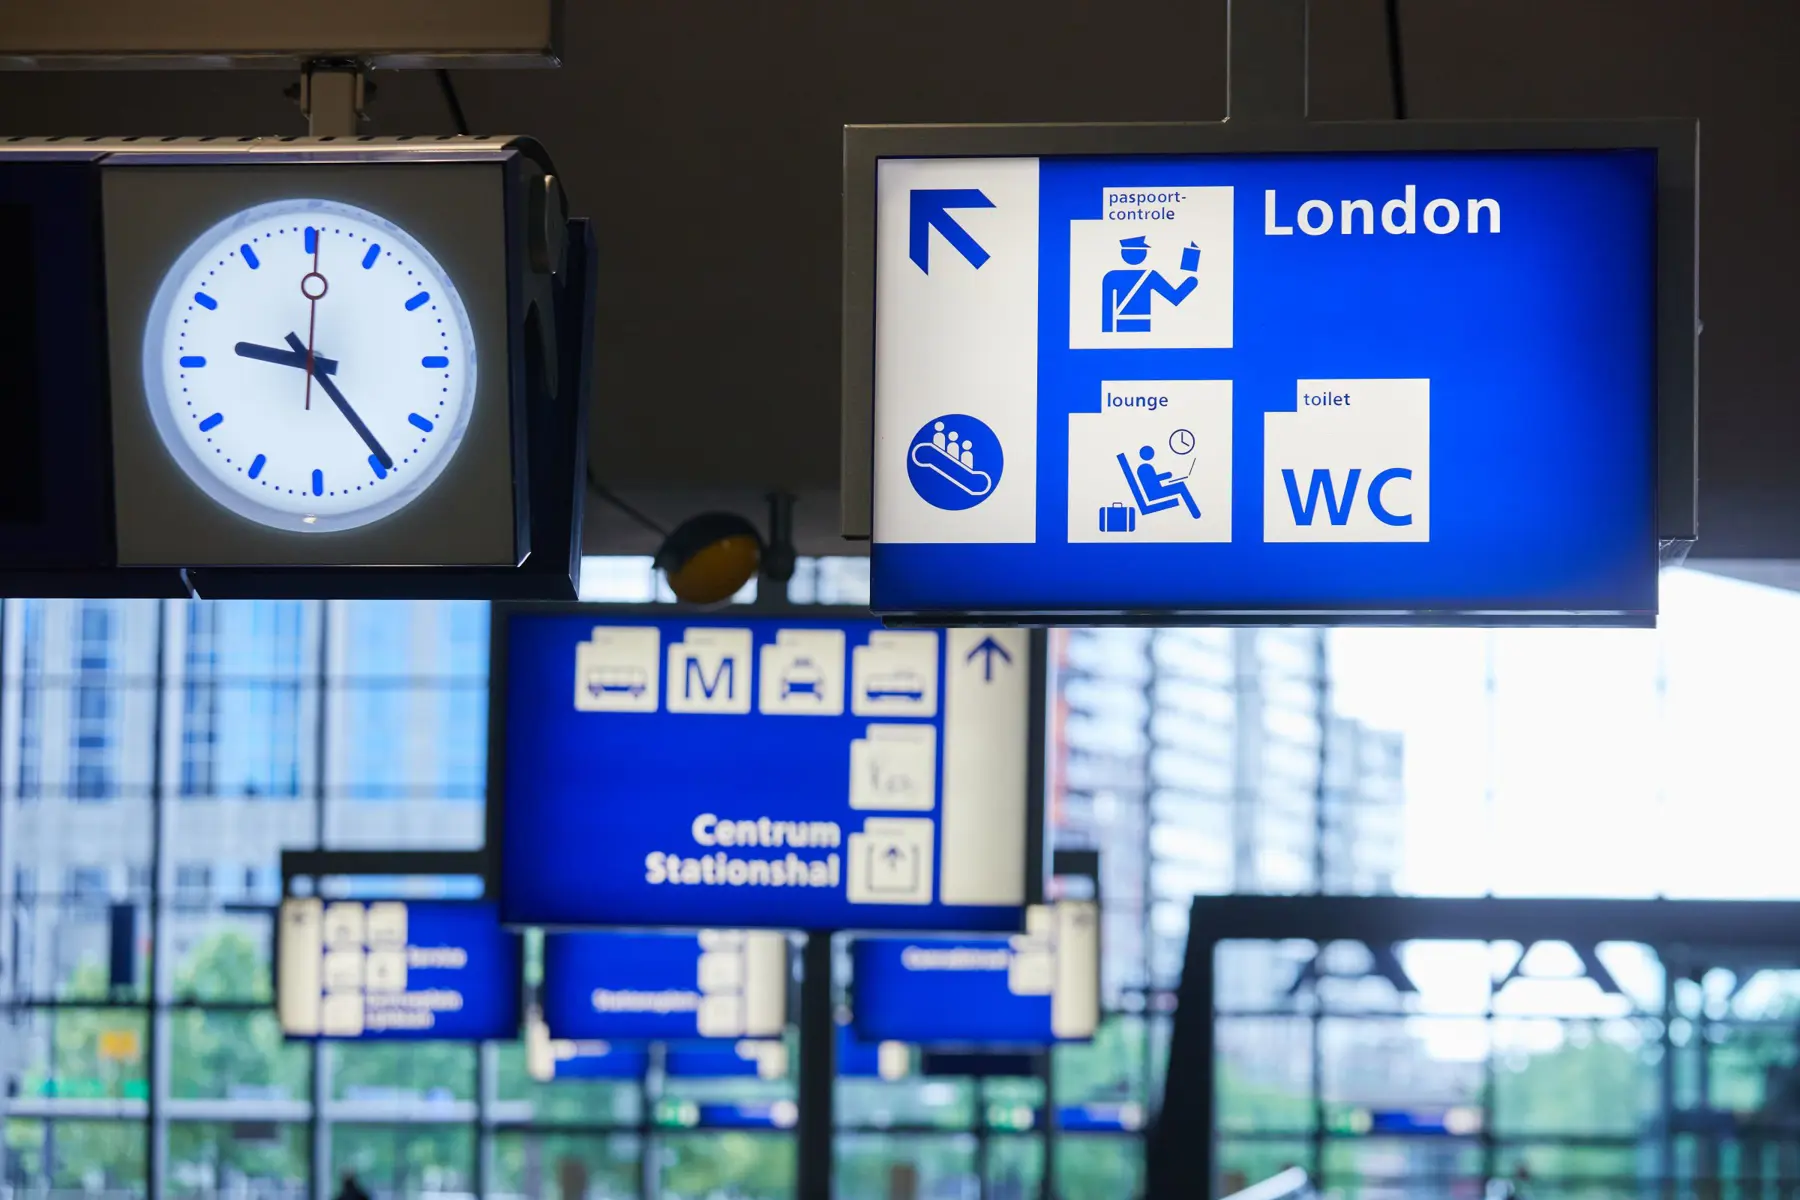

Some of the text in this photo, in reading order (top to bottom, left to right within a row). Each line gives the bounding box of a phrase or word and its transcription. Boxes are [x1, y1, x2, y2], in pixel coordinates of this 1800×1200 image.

[1108, 206, 1175, 221] controle
[1109, 191, 1187, 207] paspoort-
[1264, 184, 1501, 236] London
[1107, 392, 1169, 410] lounge
[1303, 391, 1351, 406] toilet
[1281, 467, 1413, 527] WC
[683, 656, 735, 699] M
[691, 813, 841, 847] Centrum
[645, 851, 841, 887] Stationshal
